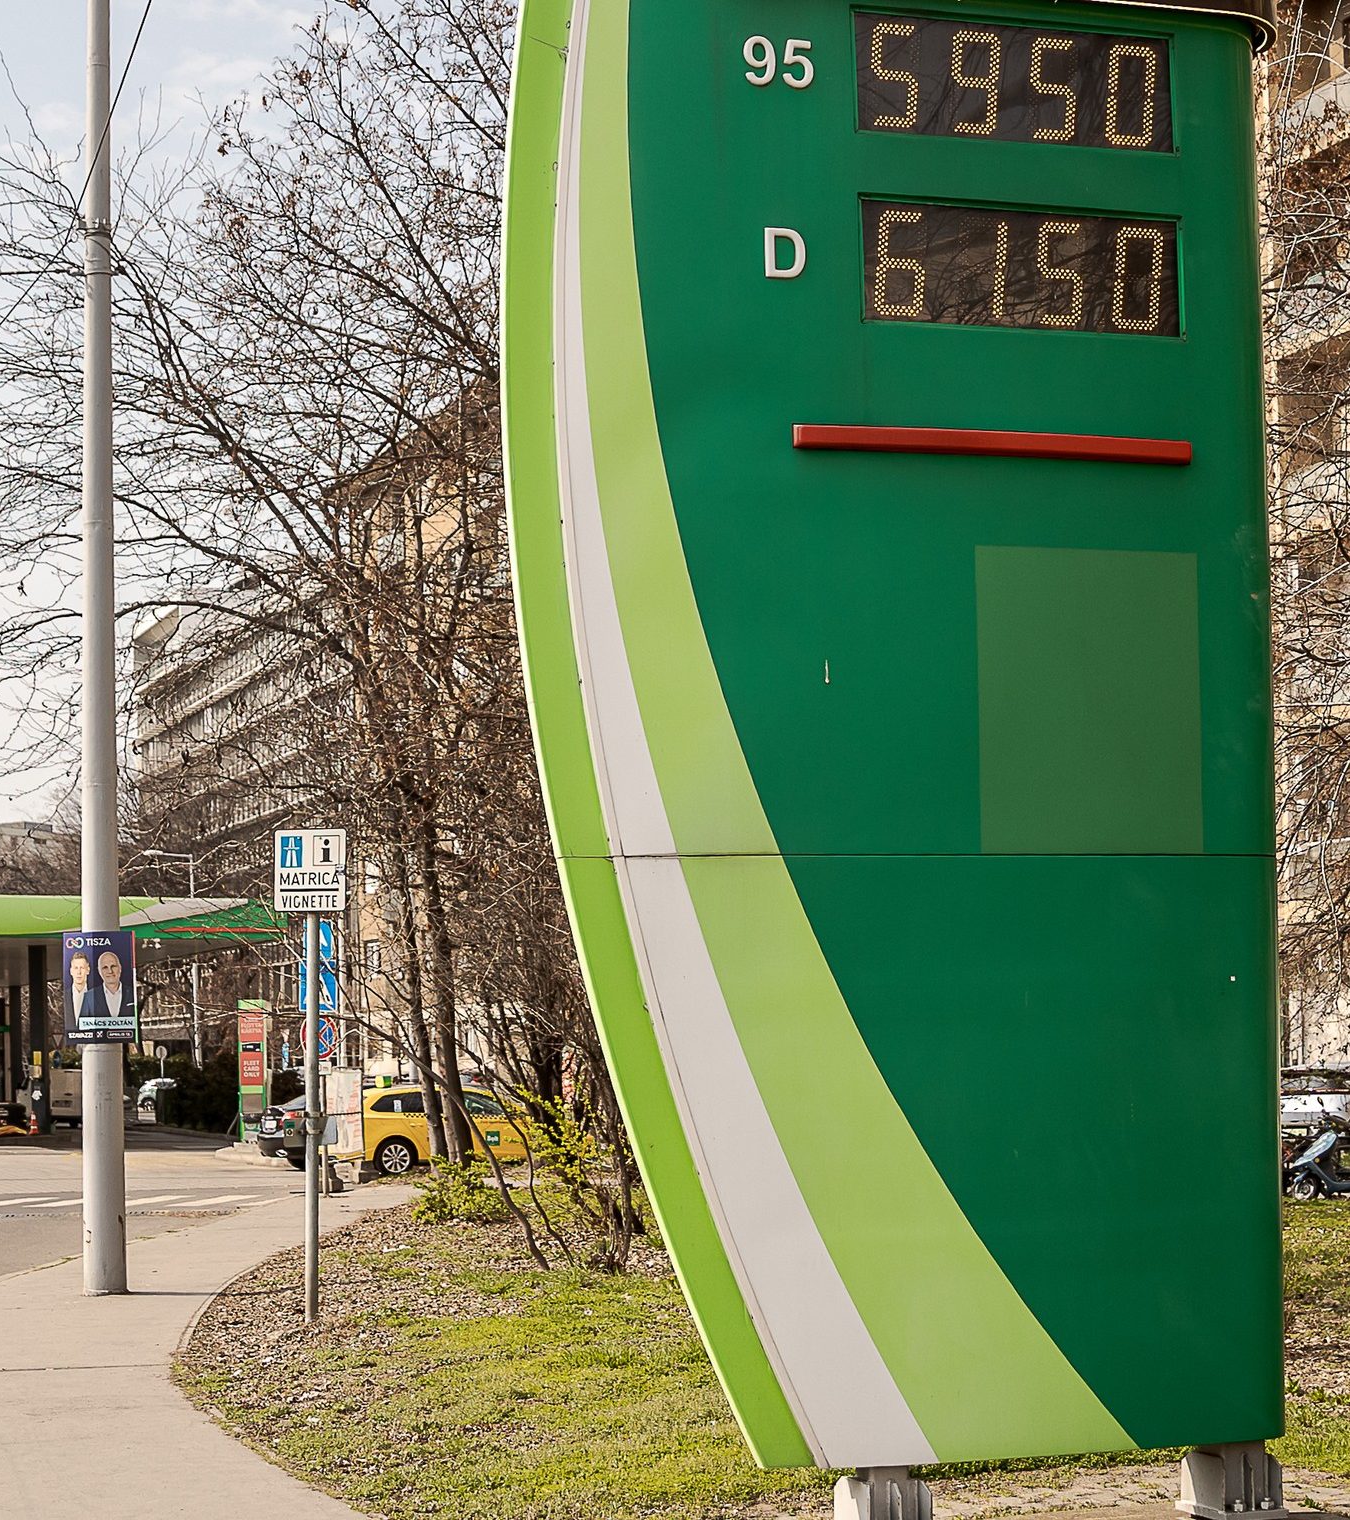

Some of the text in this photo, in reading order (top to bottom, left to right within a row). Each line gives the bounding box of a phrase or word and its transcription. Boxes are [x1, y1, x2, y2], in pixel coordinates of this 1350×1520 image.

[742, 22, 1157, 147] 95 5950
[762, 210, 1163, 331] D 6150
[280, 872, 340, 886] MATRICA
[281, 895, 337, 908] VIGNETTE
[86, 938, 111, 946] TISZA
[108, 1018, 133, 1026] ZOLTÁN
